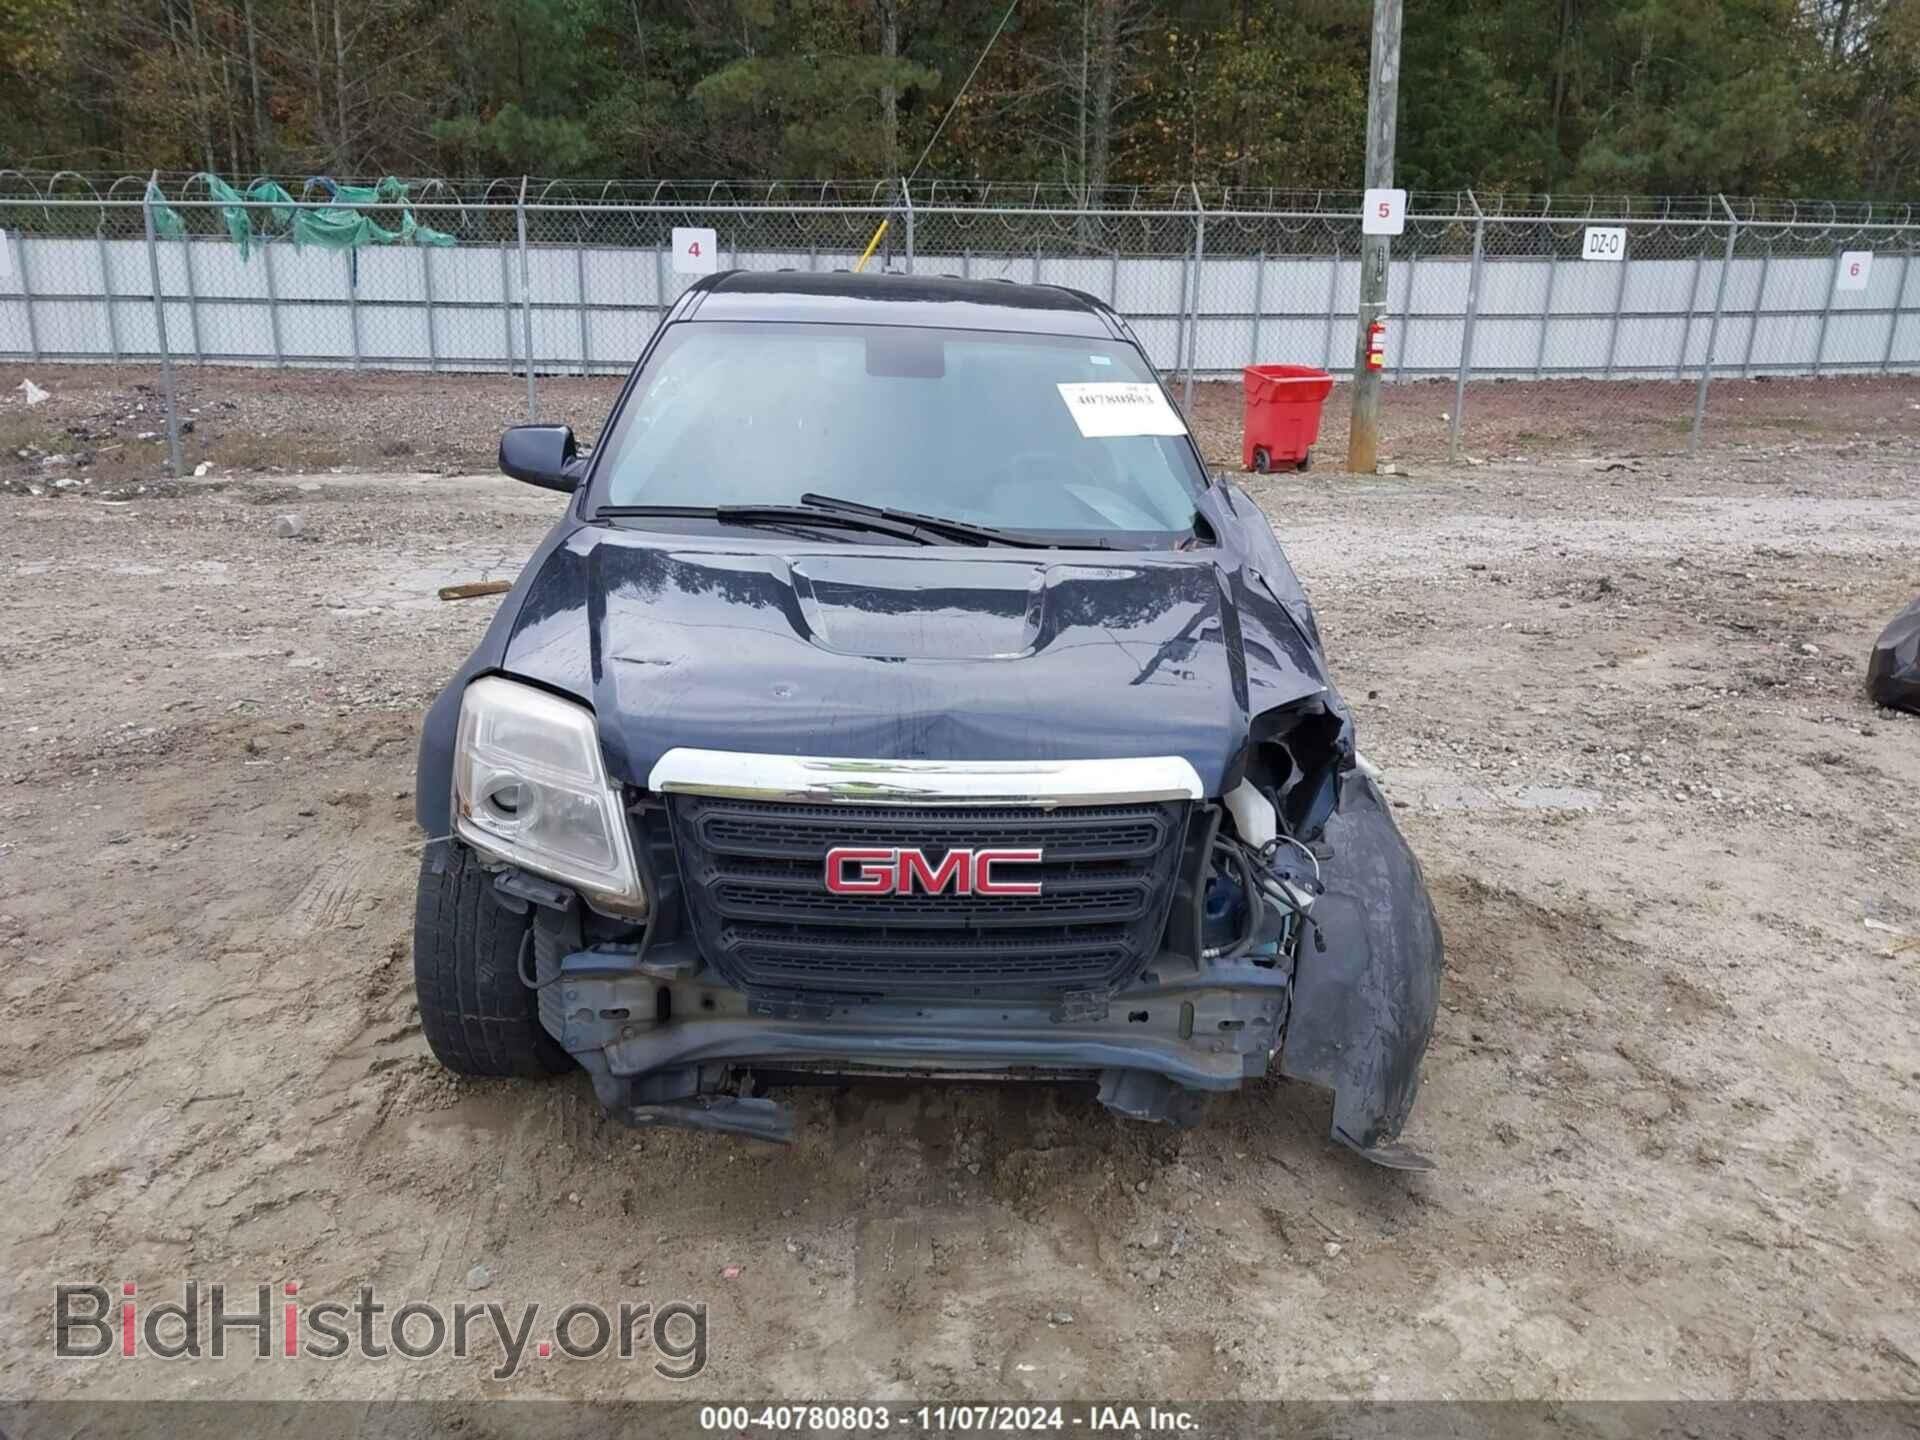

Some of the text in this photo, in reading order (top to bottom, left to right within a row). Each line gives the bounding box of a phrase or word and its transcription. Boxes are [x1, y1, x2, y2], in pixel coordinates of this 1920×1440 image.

[1378, 202, 1390, 218] 5
[688, 242, 702, 257] 4
[1850, 263, 1861, 277] 6
[825, 847, 1043, 896] GMC
